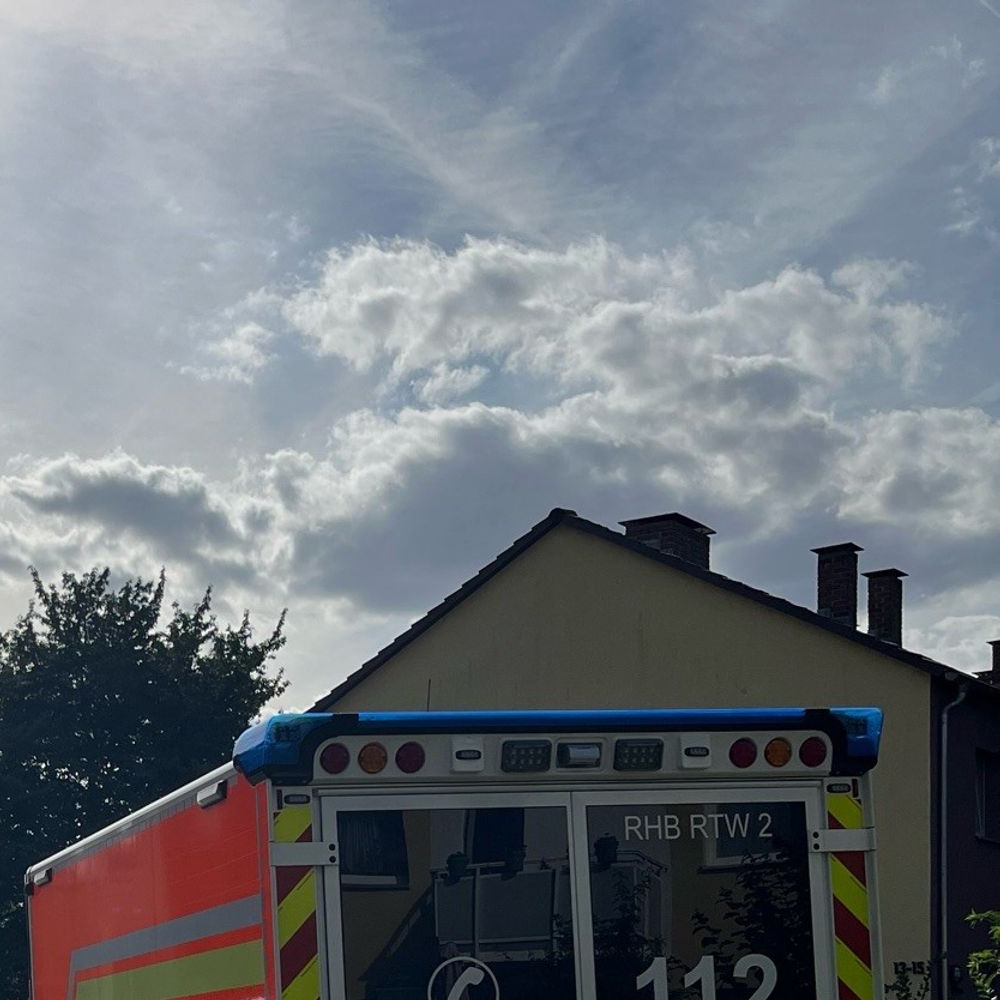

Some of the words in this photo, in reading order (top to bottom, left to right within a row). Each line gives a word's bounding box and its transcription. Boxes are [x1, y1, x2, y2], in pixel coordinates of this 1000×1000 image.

[624, 815, 680, 841] RHB
[690, 813, 750, 839] RTW
[757, 813, 774, 839] 2
